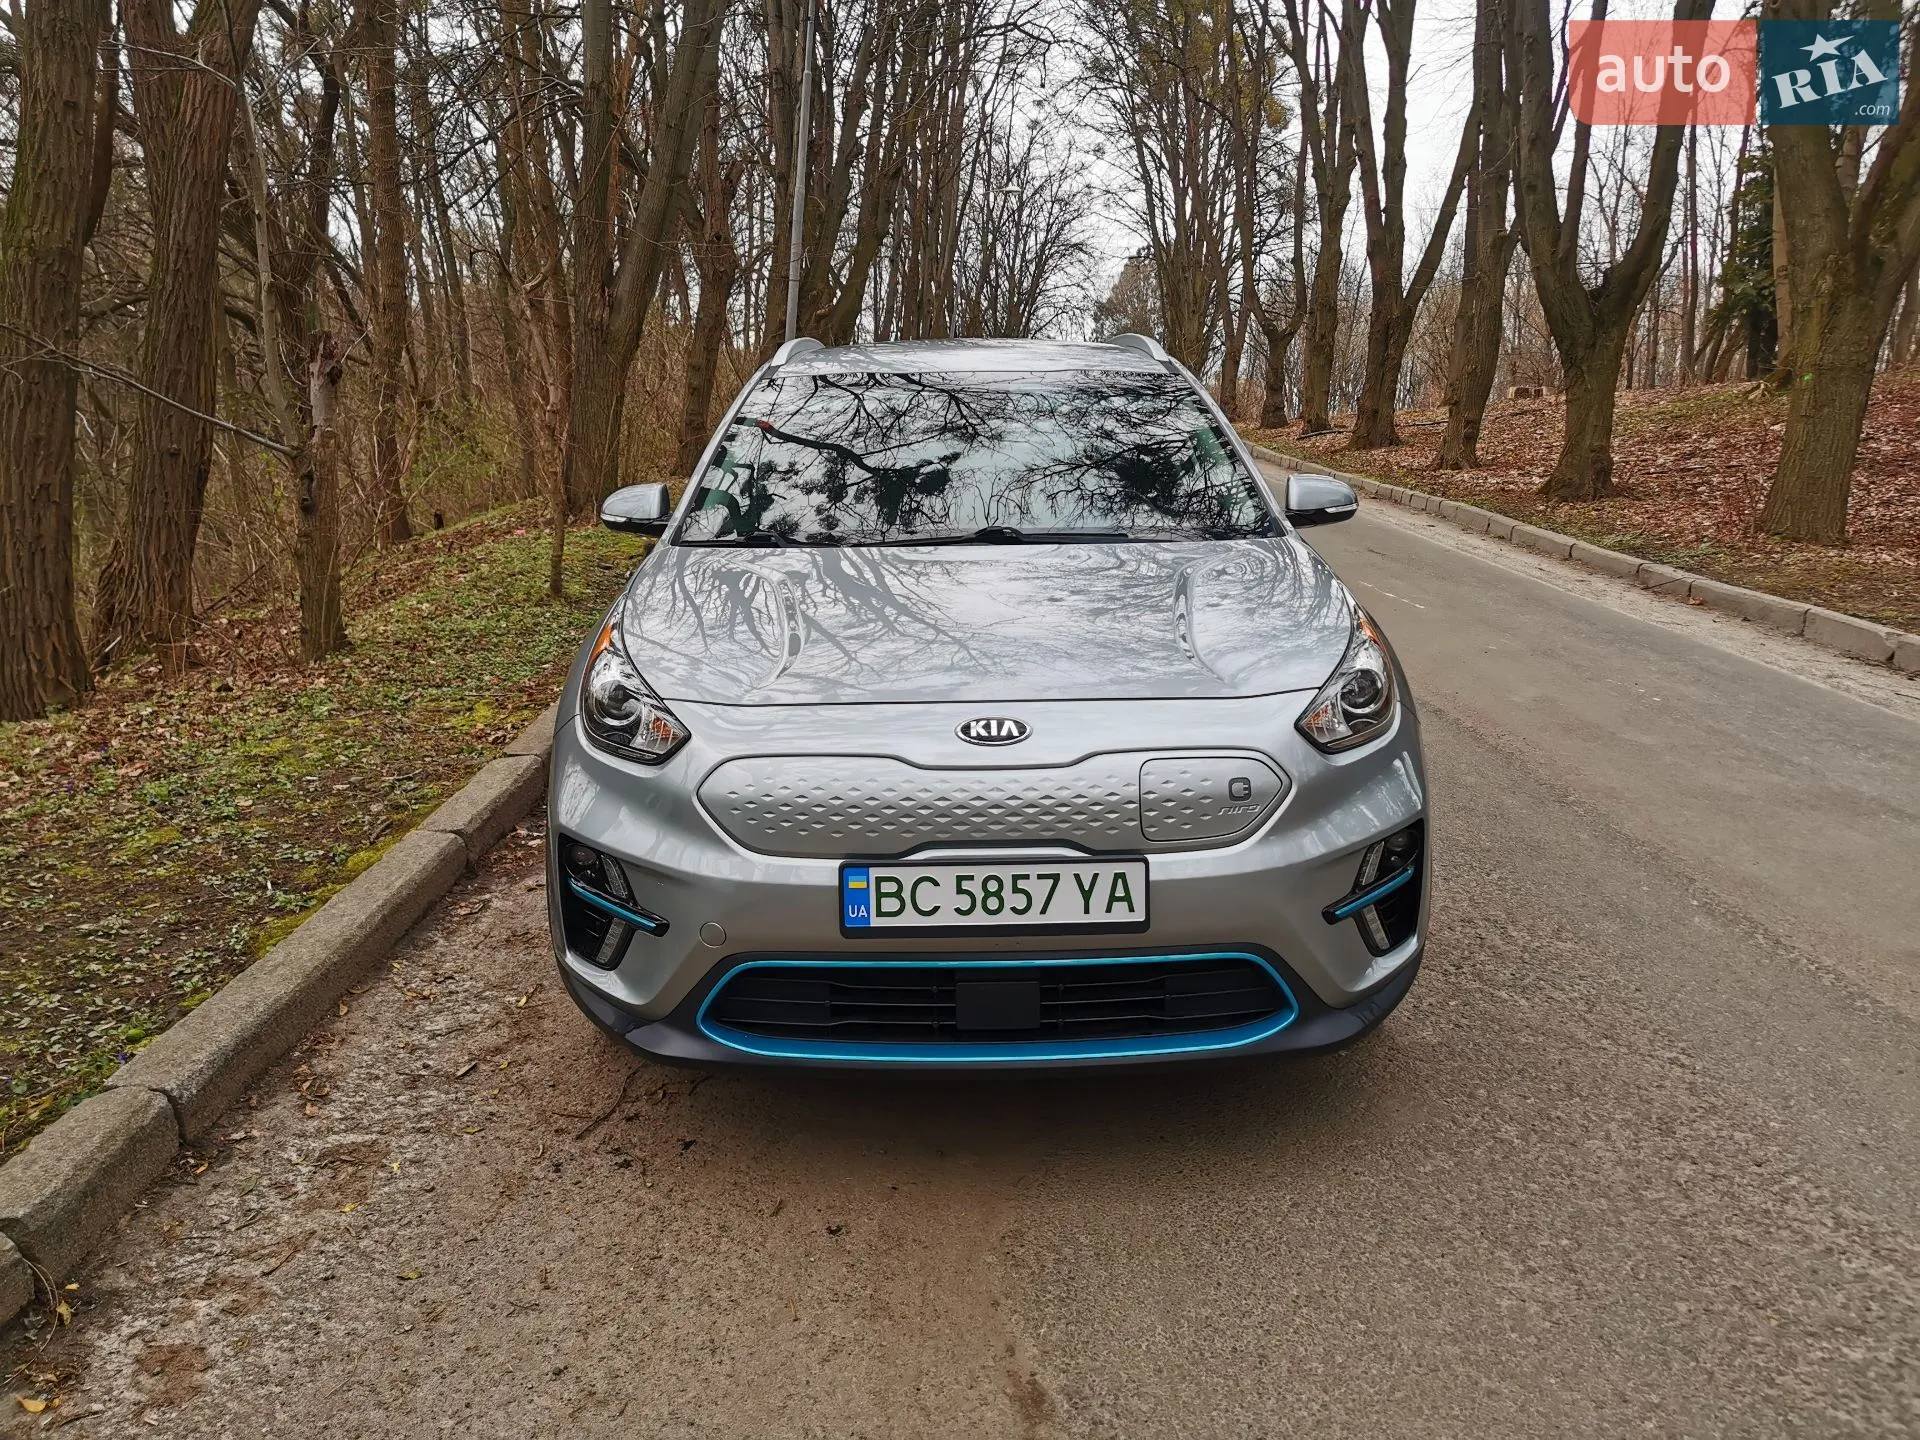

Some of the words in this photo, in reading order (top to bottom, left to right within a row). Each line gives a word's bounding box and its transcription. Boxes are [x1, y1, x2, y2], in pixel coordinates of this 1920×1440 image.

[969, 719, 1020, 737] KIA
[874, 875, 942, 918] BC
[953, 872, 1061, 916] 5857
[1073, 871, 1135, 915] YA
[848, 904, 868, 918] UA
